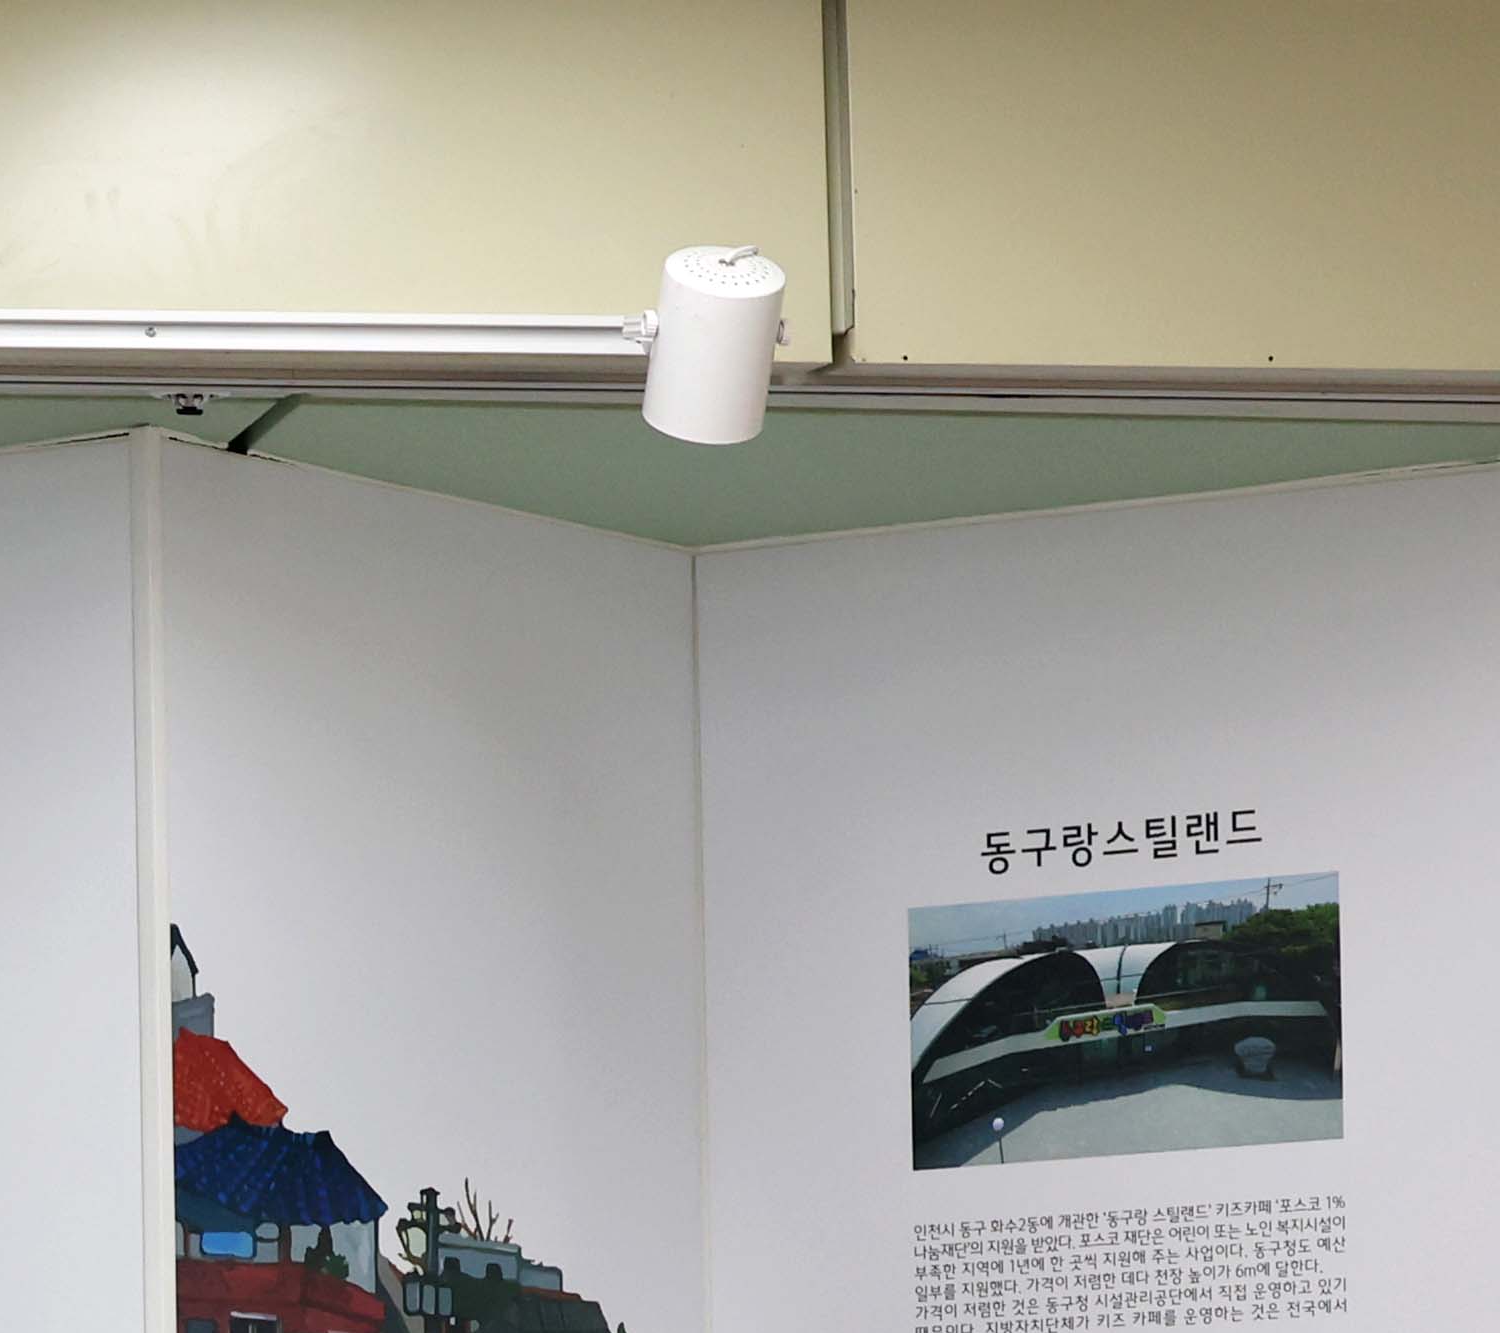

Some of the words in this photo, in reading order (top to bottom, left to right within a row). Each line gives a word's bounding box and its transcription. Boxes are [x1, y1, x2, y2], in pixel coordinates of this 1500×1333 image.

[980, 809, 1263, 875] 동구랑스틸랜드
[914, 1263, 956, 1282] 부족한
[962, 1259, 1004, 1277] 지역에
[1010, 1256, 1044, 1275] 1년에
[1047, 1255, 1065, 1273] 한
[1069, 1252, 1097, 1272] 곳씩
[1103, 1249, 1146, 1268] 지원해
[1152, 1247, 1180, 1265] 주는
[1185, 1243, 1248, 1263] 사업이다.
[1252, 1238, 1312, 1260] 동구청도
[1317, 1235, 1346, 1254] 예산
